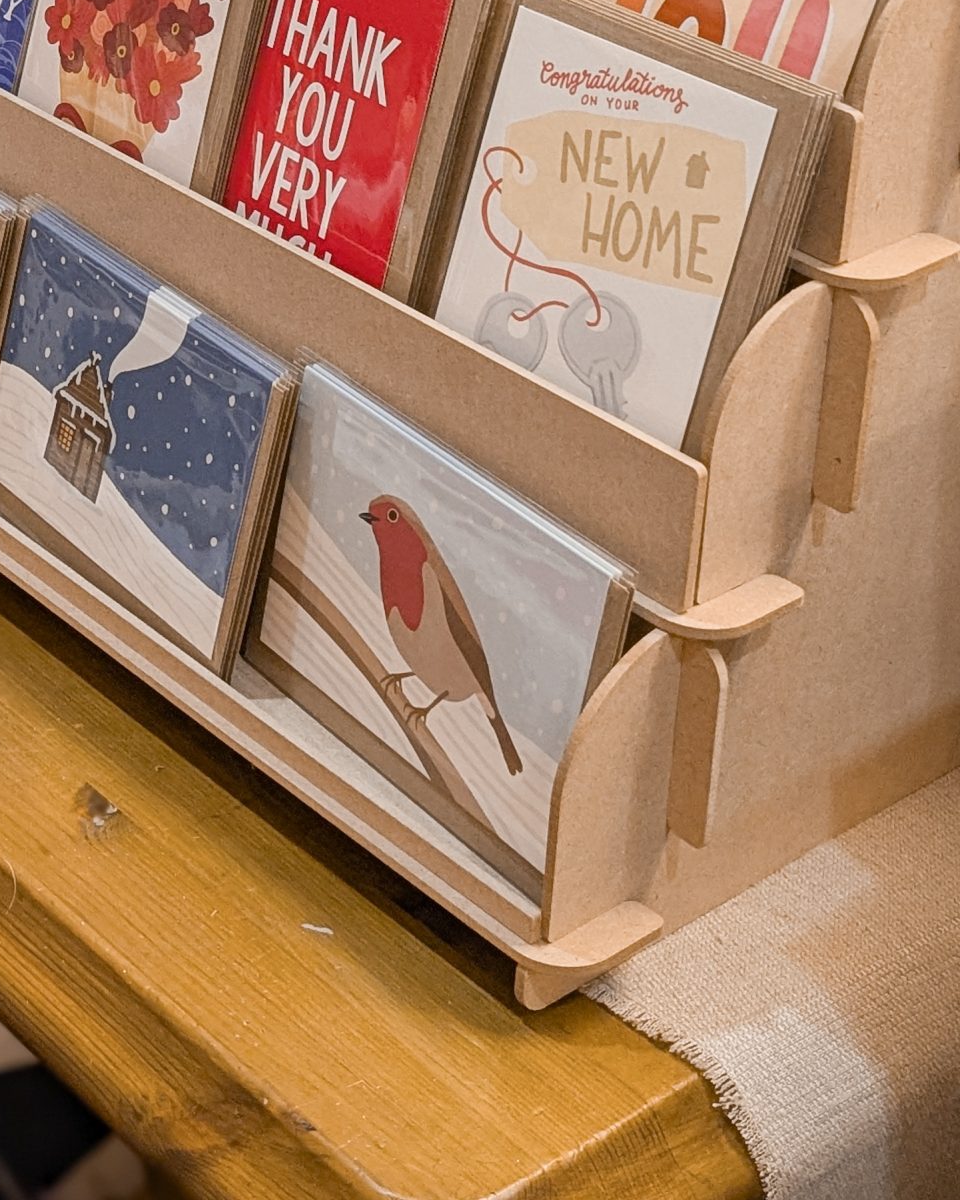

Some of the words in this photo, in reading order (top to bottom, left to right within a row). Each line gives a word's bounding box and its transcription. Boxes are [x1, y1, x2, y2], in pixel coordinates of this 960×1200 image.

[276, 65, 356, 162] YOU
[540, 60, 688, 114] Congratulations
[581, 94, 598, 106] ON
[606, 97, 639, 112] YOUR
[251, 131, 348, 240] VERY
[560, 129, 666, 194] NEW
[582, 192, 721, 284] HOME
